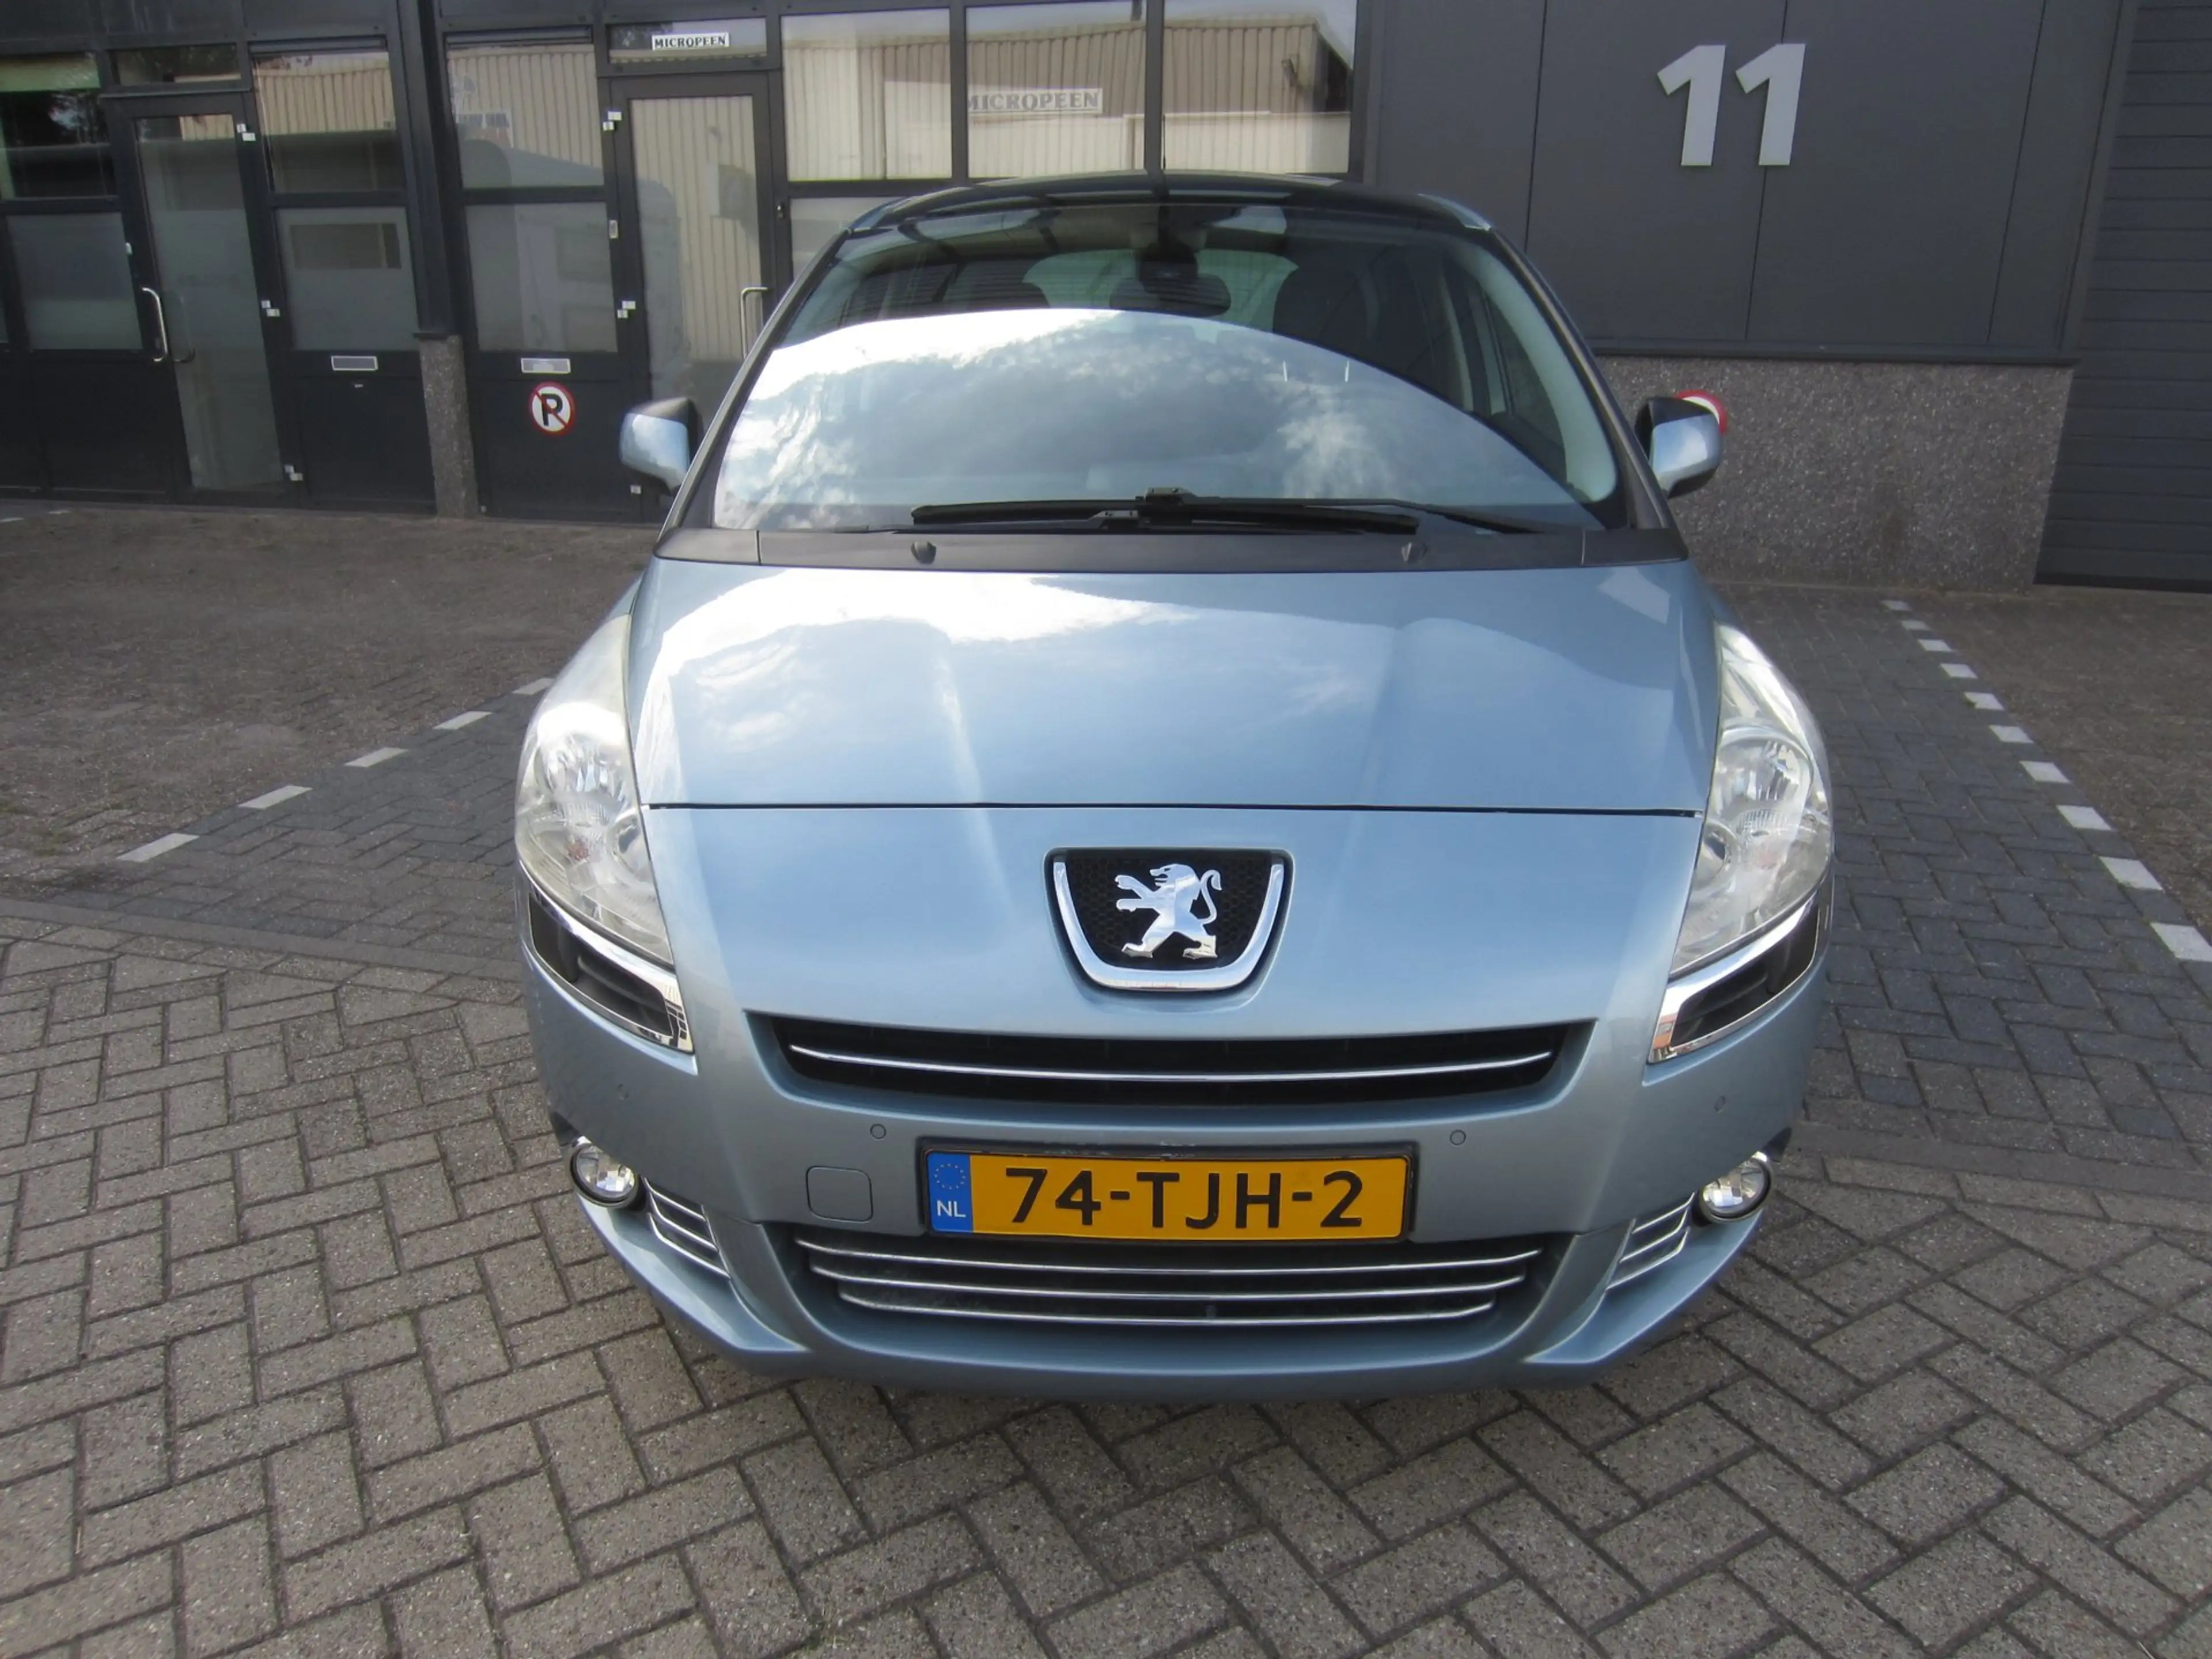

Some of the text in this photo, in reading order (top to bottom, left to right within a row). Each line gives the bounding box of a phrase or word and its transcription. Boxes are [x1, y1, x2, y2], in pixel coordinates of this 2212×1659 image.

[1657, 44, 1805, 165] 11
[937, 1200, 966, 1218] NL
[1005, 1168, 1363, 1229] 74-TJH-2
